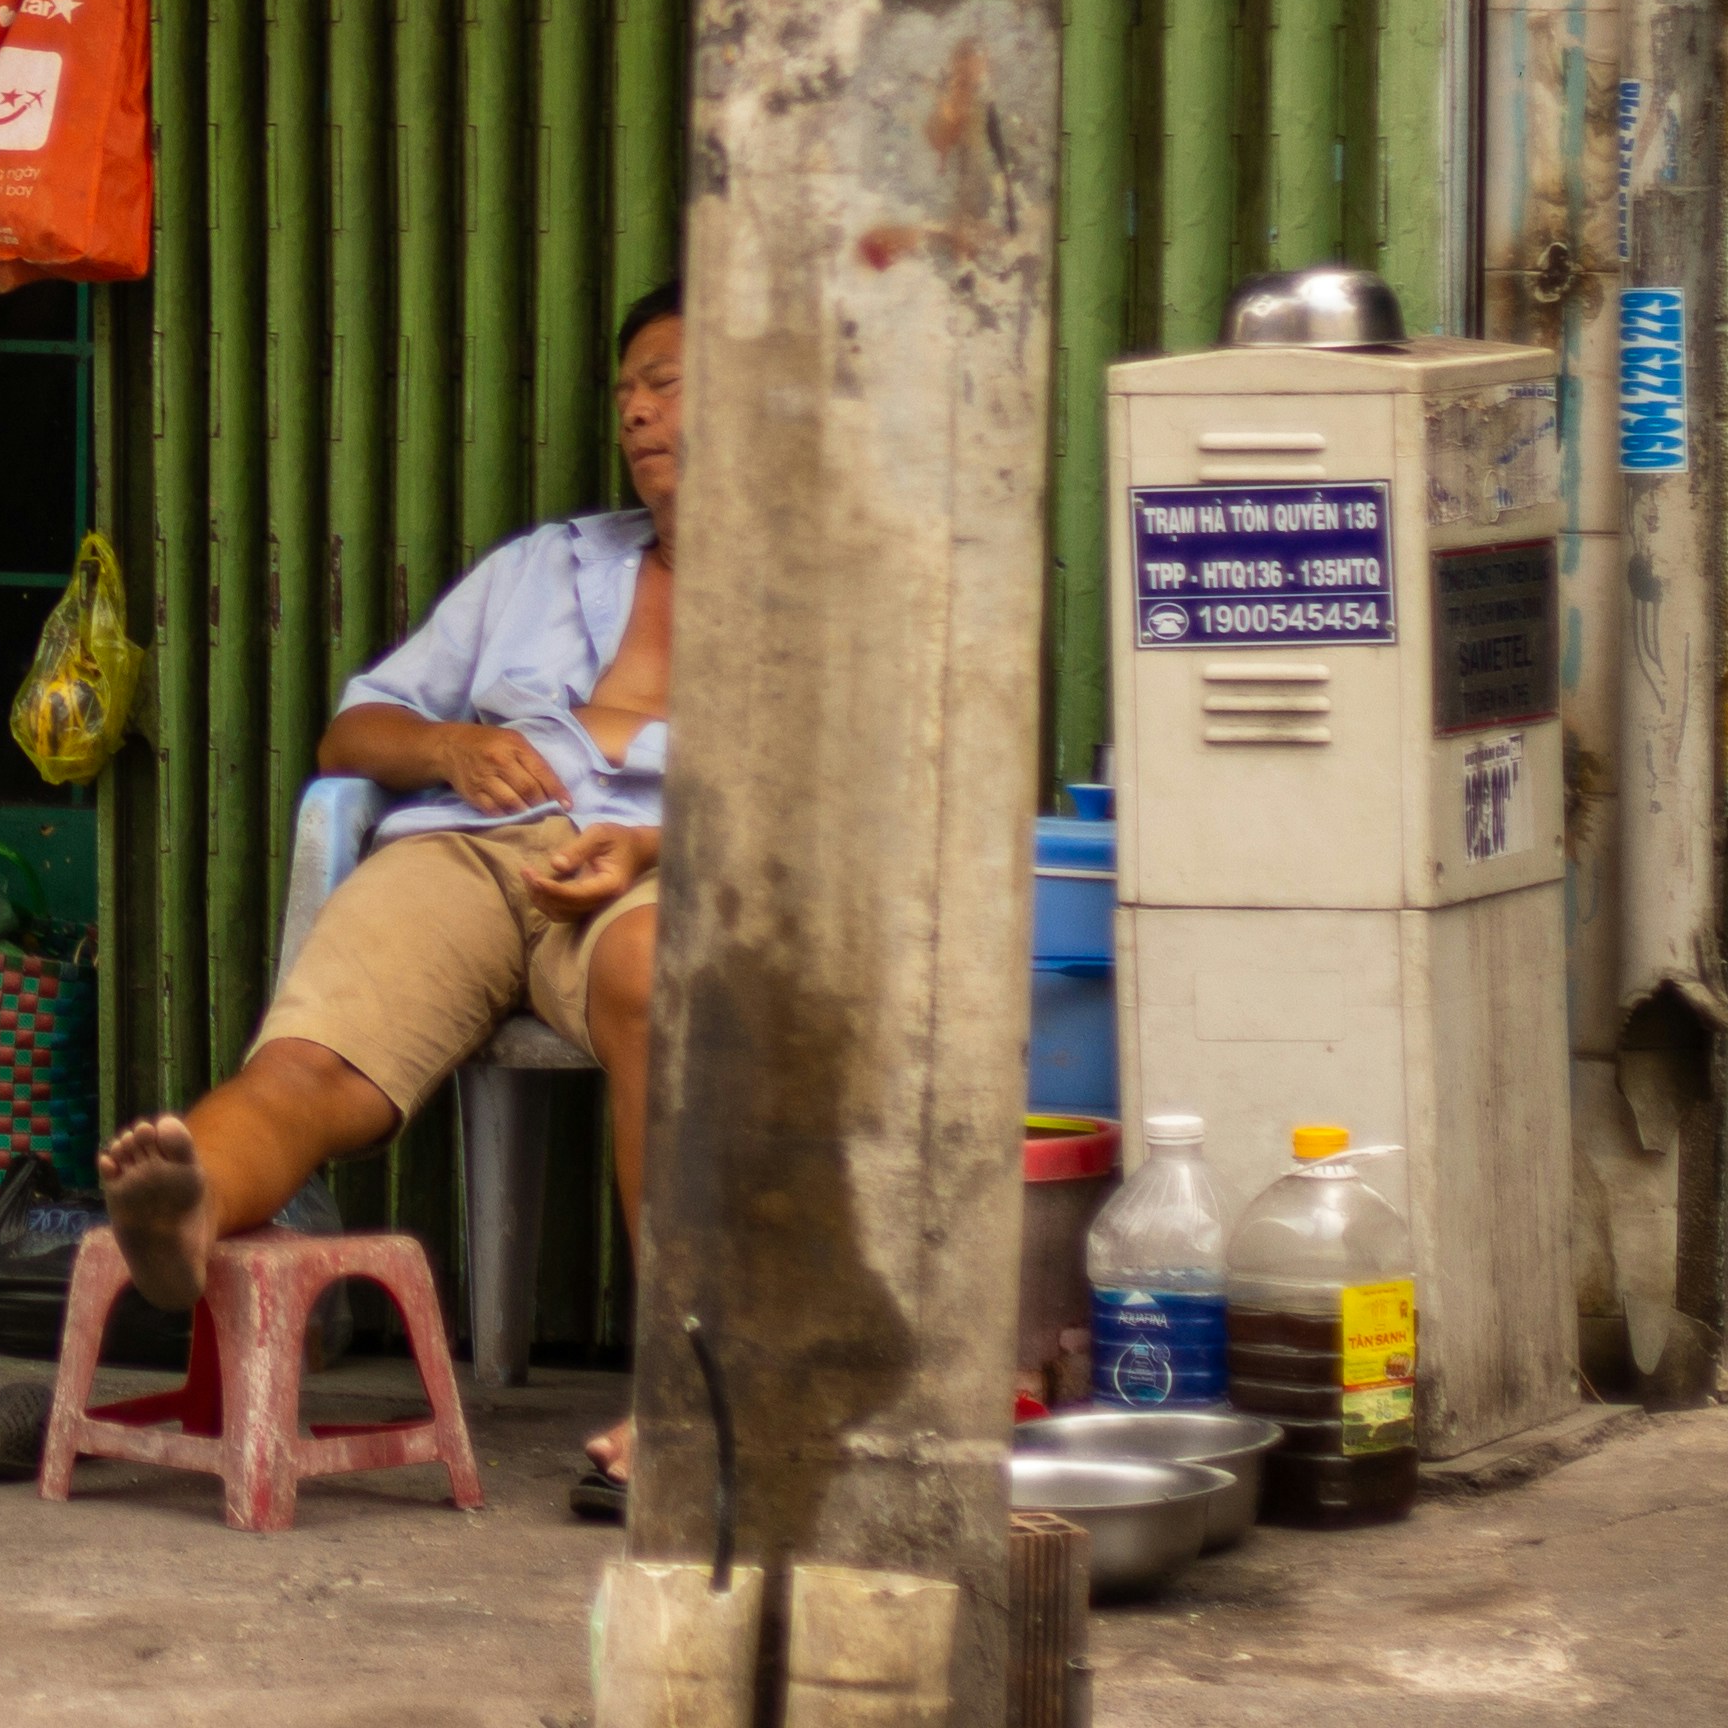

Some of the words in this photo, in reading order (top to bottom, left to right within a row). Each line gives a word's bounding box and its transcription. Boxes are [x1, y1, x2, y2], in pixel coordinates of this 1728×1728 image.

[1619, 291, 1682, 469] 0964.229.229
[1143, 505, 1196, 543] TRẠM
[1200, 498, 1228, 533] HÀ
[1229, 498, 1269, 532] TÔN
[1273, 490, 1340, 532] QUYỀN
[1344, 503, 1377, 530] 136
[1146, 562, 1187, 590] TPP
[1202, 560, 1283, 589] HTQ136
[1300, 557, 1381, 588] 135HTQ
[1198, 601, 1380, 634] 1900545454
